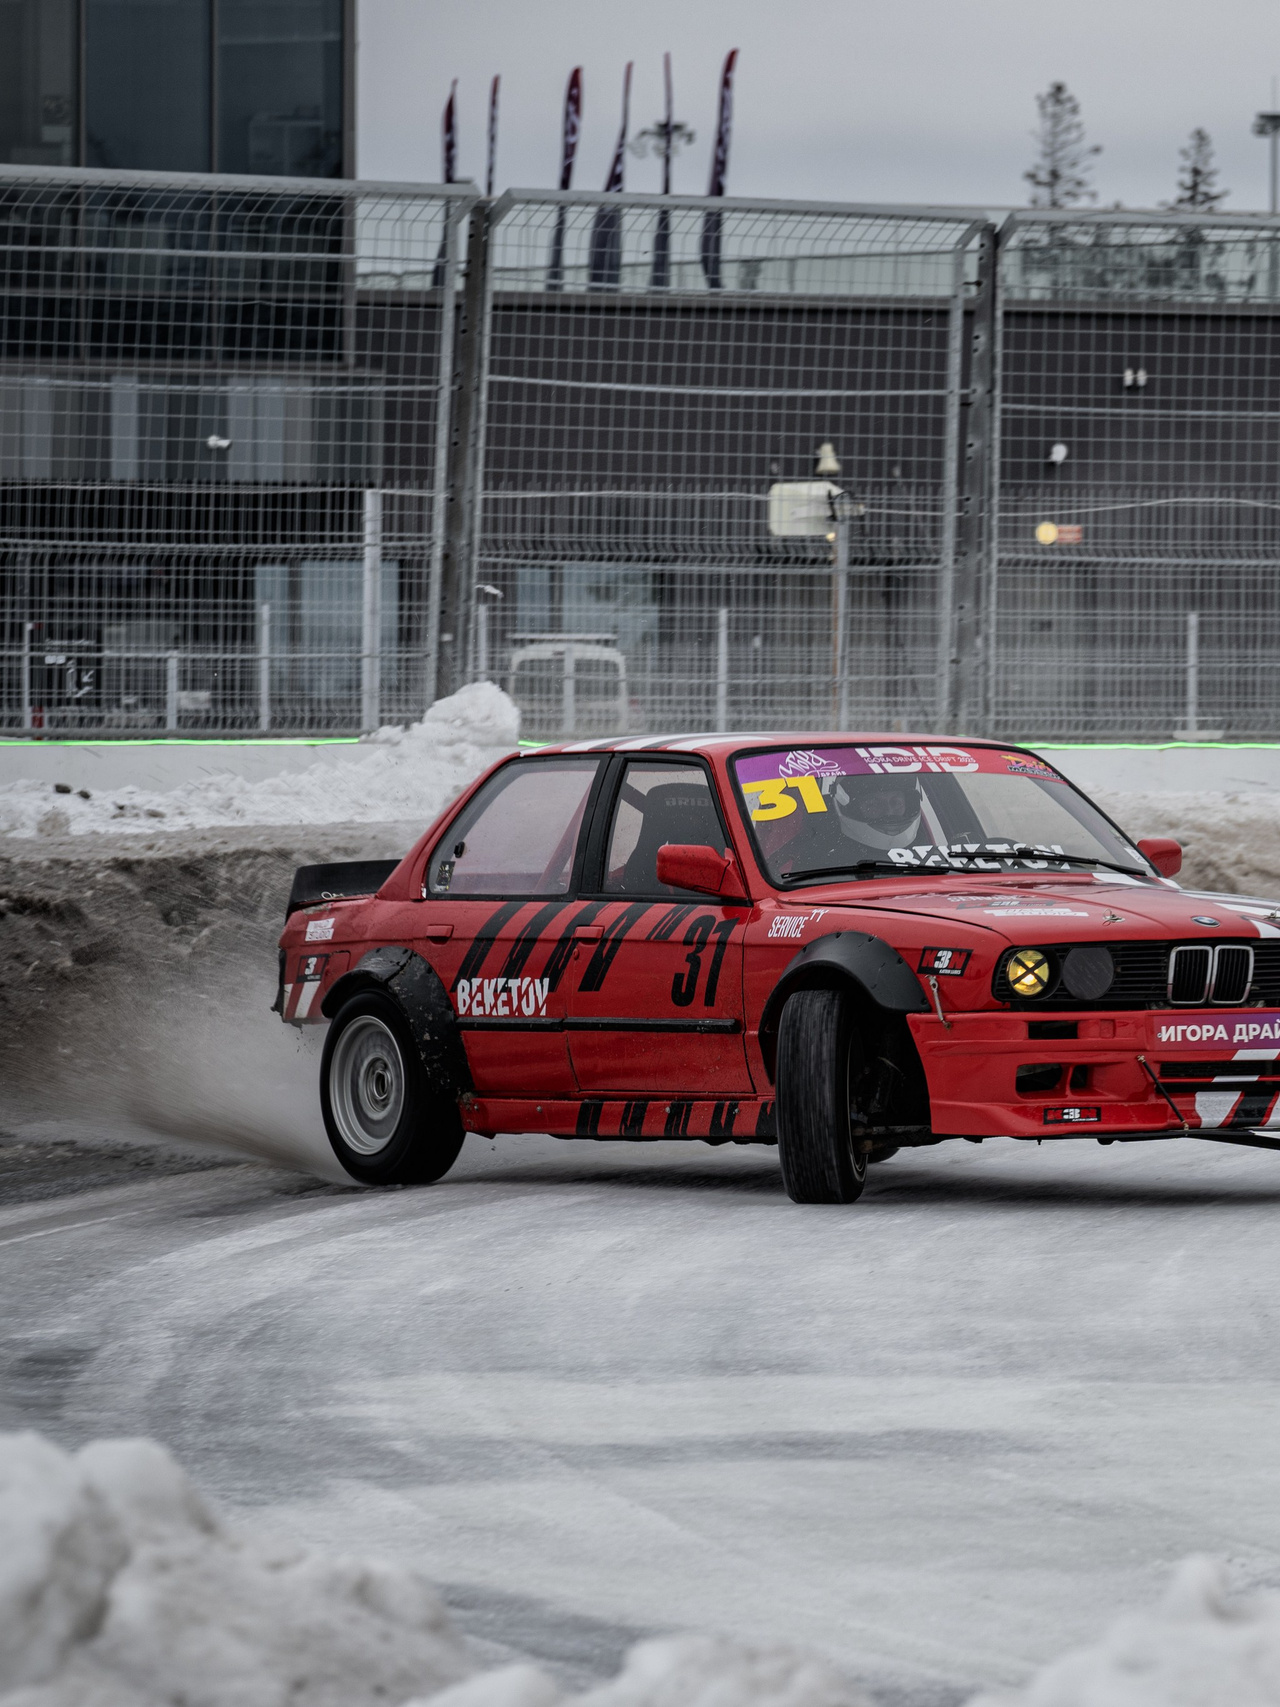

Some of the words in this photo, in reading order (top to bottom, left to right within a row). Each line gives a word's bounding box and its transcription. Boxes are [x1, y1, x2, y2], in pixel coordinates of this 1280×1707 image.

[854, 746, 979, 774] IDID
[664, 797, 714, 807] BRID
[741, 775, 828, 822] 31
[767, 915, 809, 938] SERVICE
[671, 914, 740, 1007] 31
[457, 976, 550, 1017] BEKETOV
[1161, 1024, 1229, 1042] ИГОРА
